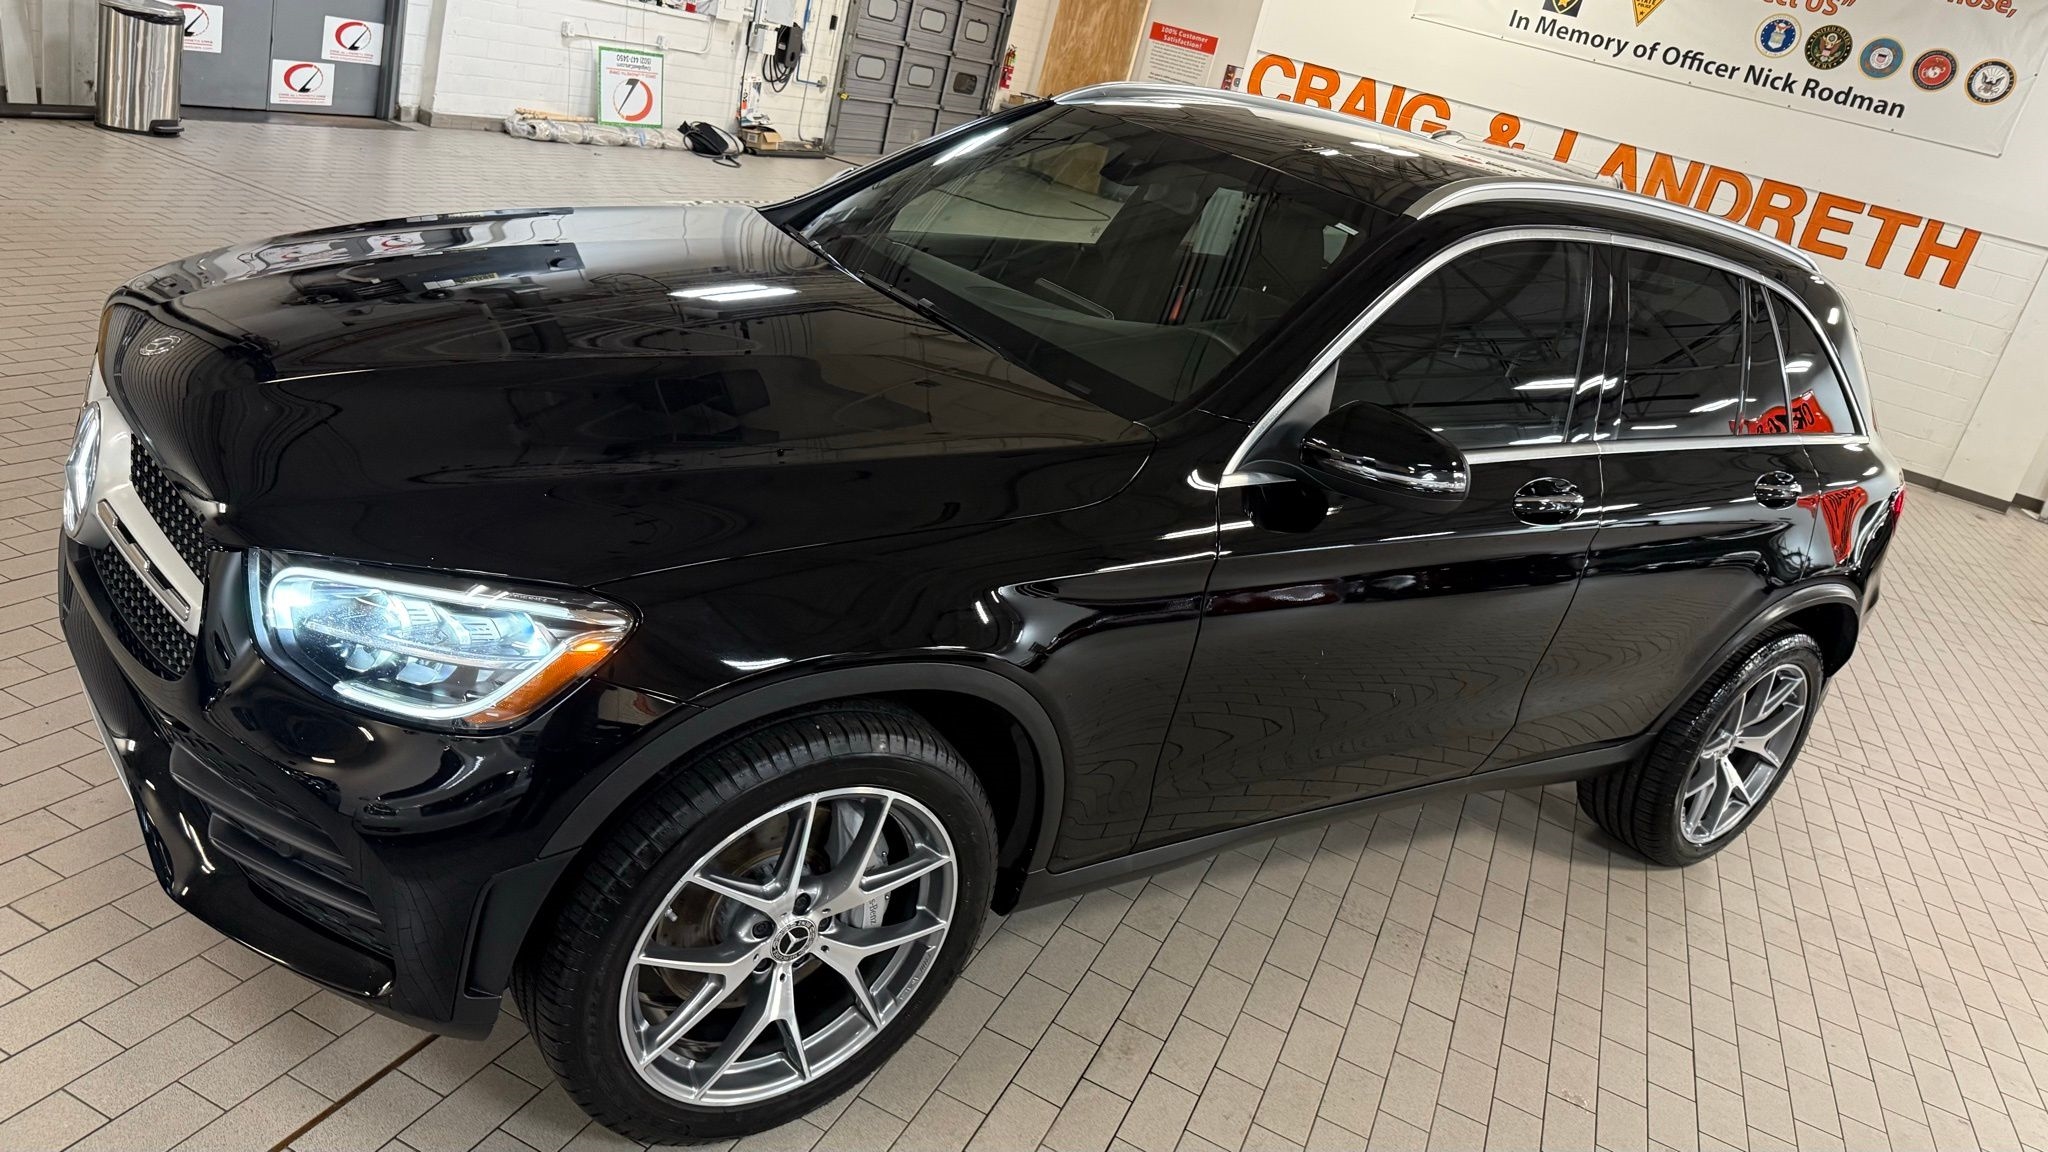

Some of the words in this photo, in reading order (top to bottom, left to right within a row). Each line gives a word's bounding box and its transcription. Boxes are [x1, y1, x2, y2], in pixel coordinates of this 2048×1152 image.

[1161, 27, 1178, 36] 100%
[1178, 31, 1209, 43] Customer
[1163, 34, 1203, 50] Satisfaction!
[1509, 9, 1530, 31] In
[1534, 16, 1630, 58] Memory
[1633, 42, 1661, 61] of
[1662, 46, 1741, 80] Officer
[1743, 64, 1799, 94] Nick
[1801, 78, 1906, 119] Rodman
[1247, 53, 1451, 135] CRAIG
[1483, 112, 1525, 150] &
